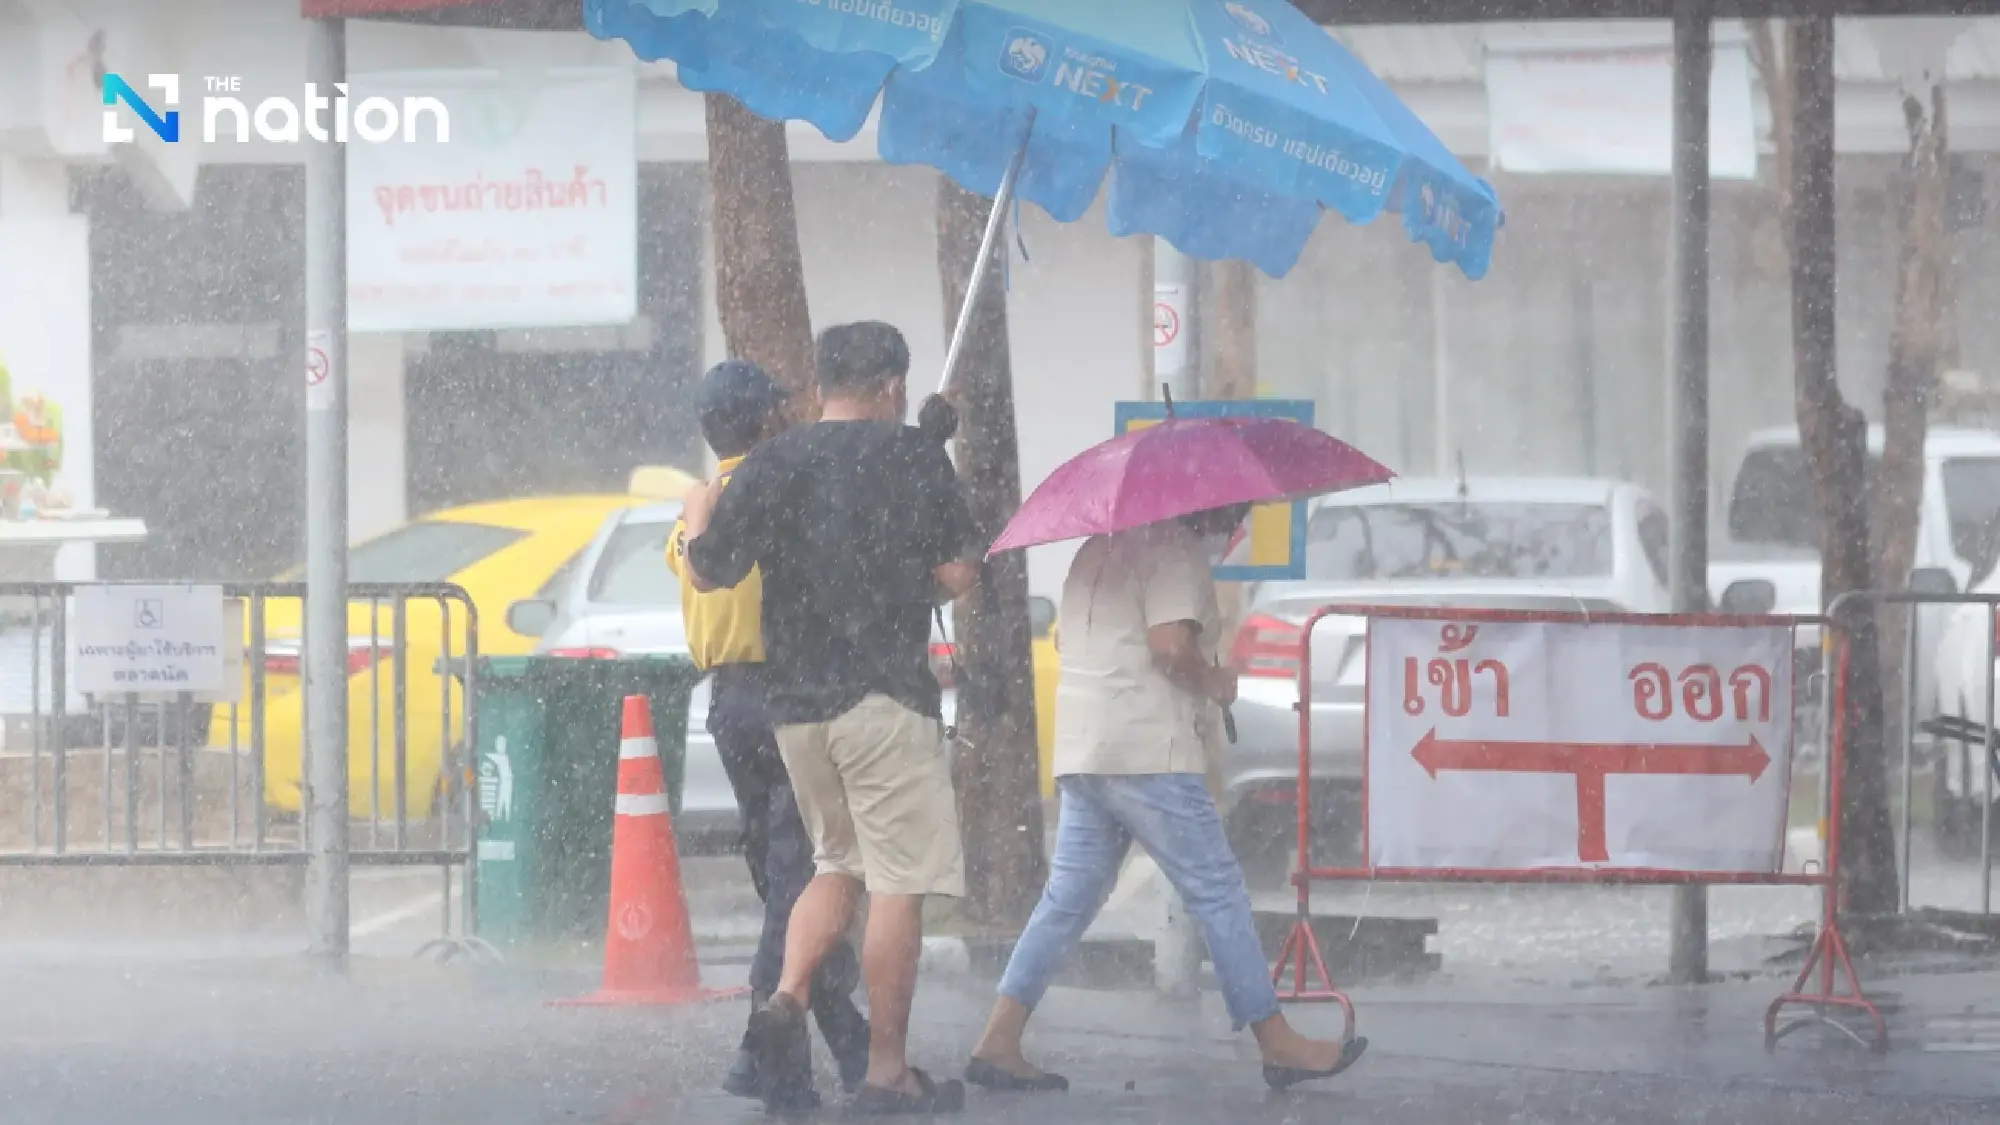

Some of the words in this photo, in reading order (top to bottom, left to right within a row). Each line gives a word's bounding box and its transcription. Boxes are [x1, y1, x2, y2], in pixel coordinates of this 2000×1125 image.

[1053, 61, 1153, 112] NEXT
[1222, 37, 1329, 95] NEXT
[1402, 623, 1510, 718] เข้า
[1627, 660, 1772, 723] ออก
